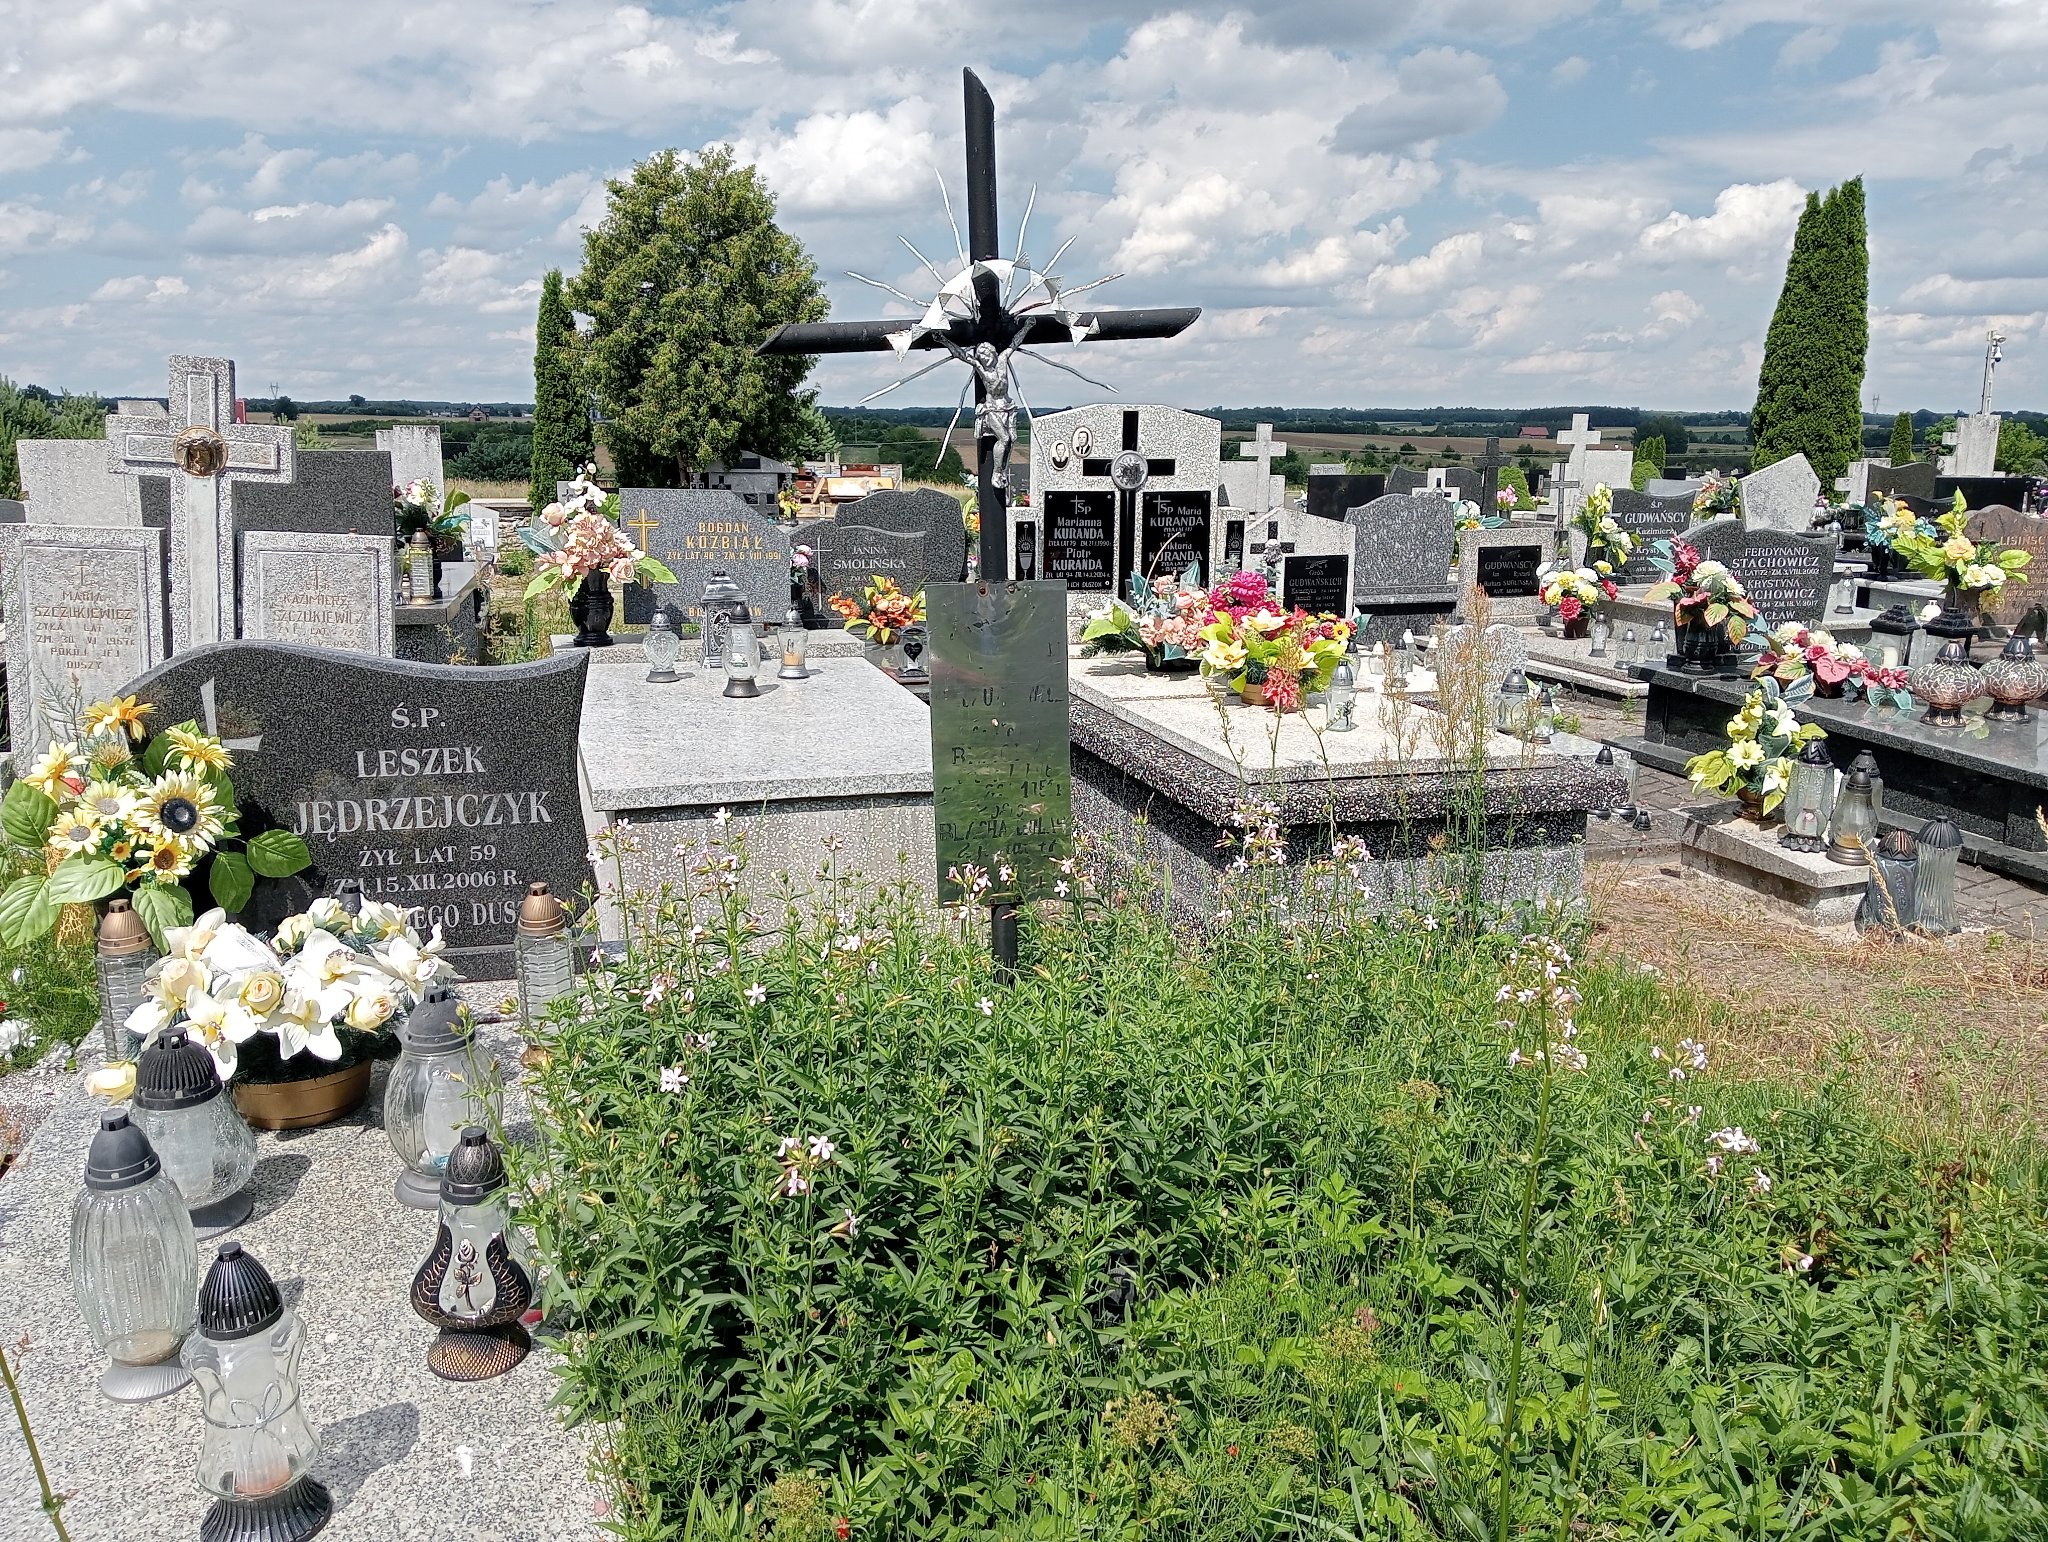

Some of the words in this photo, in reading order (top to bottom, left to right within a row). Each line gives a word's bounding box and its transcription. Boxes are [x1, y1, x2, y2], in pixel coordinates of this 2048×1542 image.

[1177, 506, 1202, 515] Maria
[1625, 510, 1686, 523] GUDWAŃSCY
[698, 522, 749, 533] BOGDAN
[1057, 516, 1102, 527] Marianna
[1149, 516, 1204, 527] KURANDA
[1053, 527, 1104, 540] KURANDA
[685, 551, 700, 560] LAT
[851, 546, 888, 555] JANINA
[1066, 547, 1092, 559] Piotr
[1745, 547, 1809, 557] FERDYNAND
[833, 557, 907, 570] SMOLIŃSKA
[1052, 559, 1103, 571] KURANDA
[1732, 556, 1819, 569] STACHOWICZ
[1747, 579, 1800, 589] KRYSTYNA
[1745, 588, 1816, 600] ACHOWICZ
[66, 661, 103, 669] DUSZY
[391, 702, 446, 729] Ś.P.
[355, 745, 487, 779] LESZEK
[293, 790, 553, 843] JĘDRZEJCZYK
[359, 845, 402, 868] ŻYŁ
[413, 845, 458, 865] LAT
[469, 844, 497, 862] 59
[502, 869, 523, 887] R.
